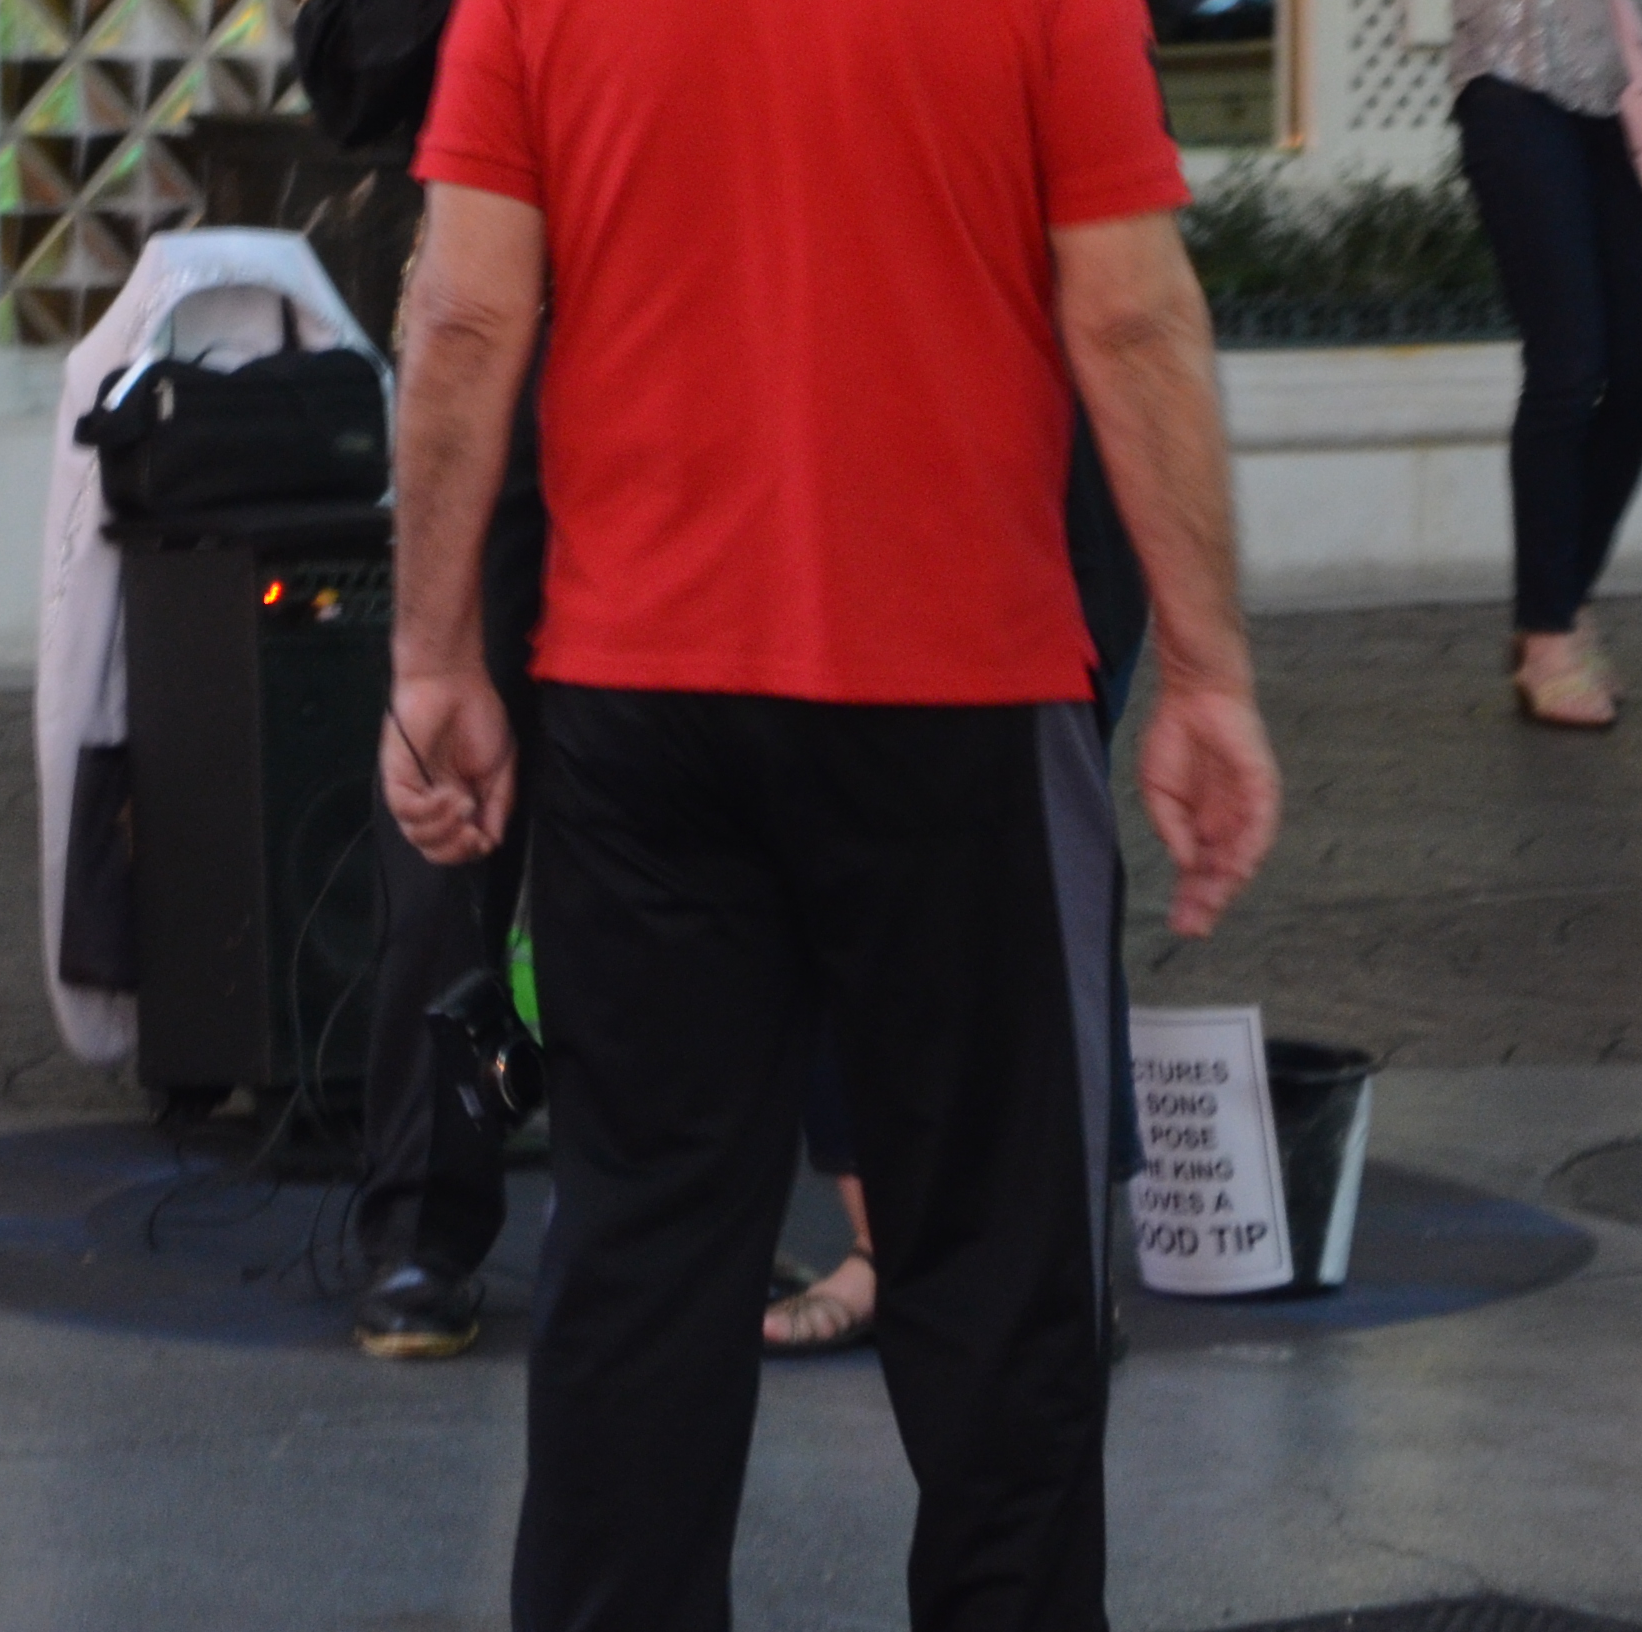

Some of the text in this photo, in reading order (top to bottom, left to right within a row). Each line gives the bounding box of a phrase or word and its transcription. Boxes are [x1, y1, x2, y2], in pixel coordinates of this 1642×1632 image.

[1132, 1059, 1229, 1085] CTURES
[1147, 1091, 1218, 1118] SONG
[1150, 1125, 1217, 1150] POSE
[1172, 1156, 1234, 1182] KING
[1142, 1187, 1234, 1215] OVES A
[1139, 1221, 1268, 1257] OOD TIP
